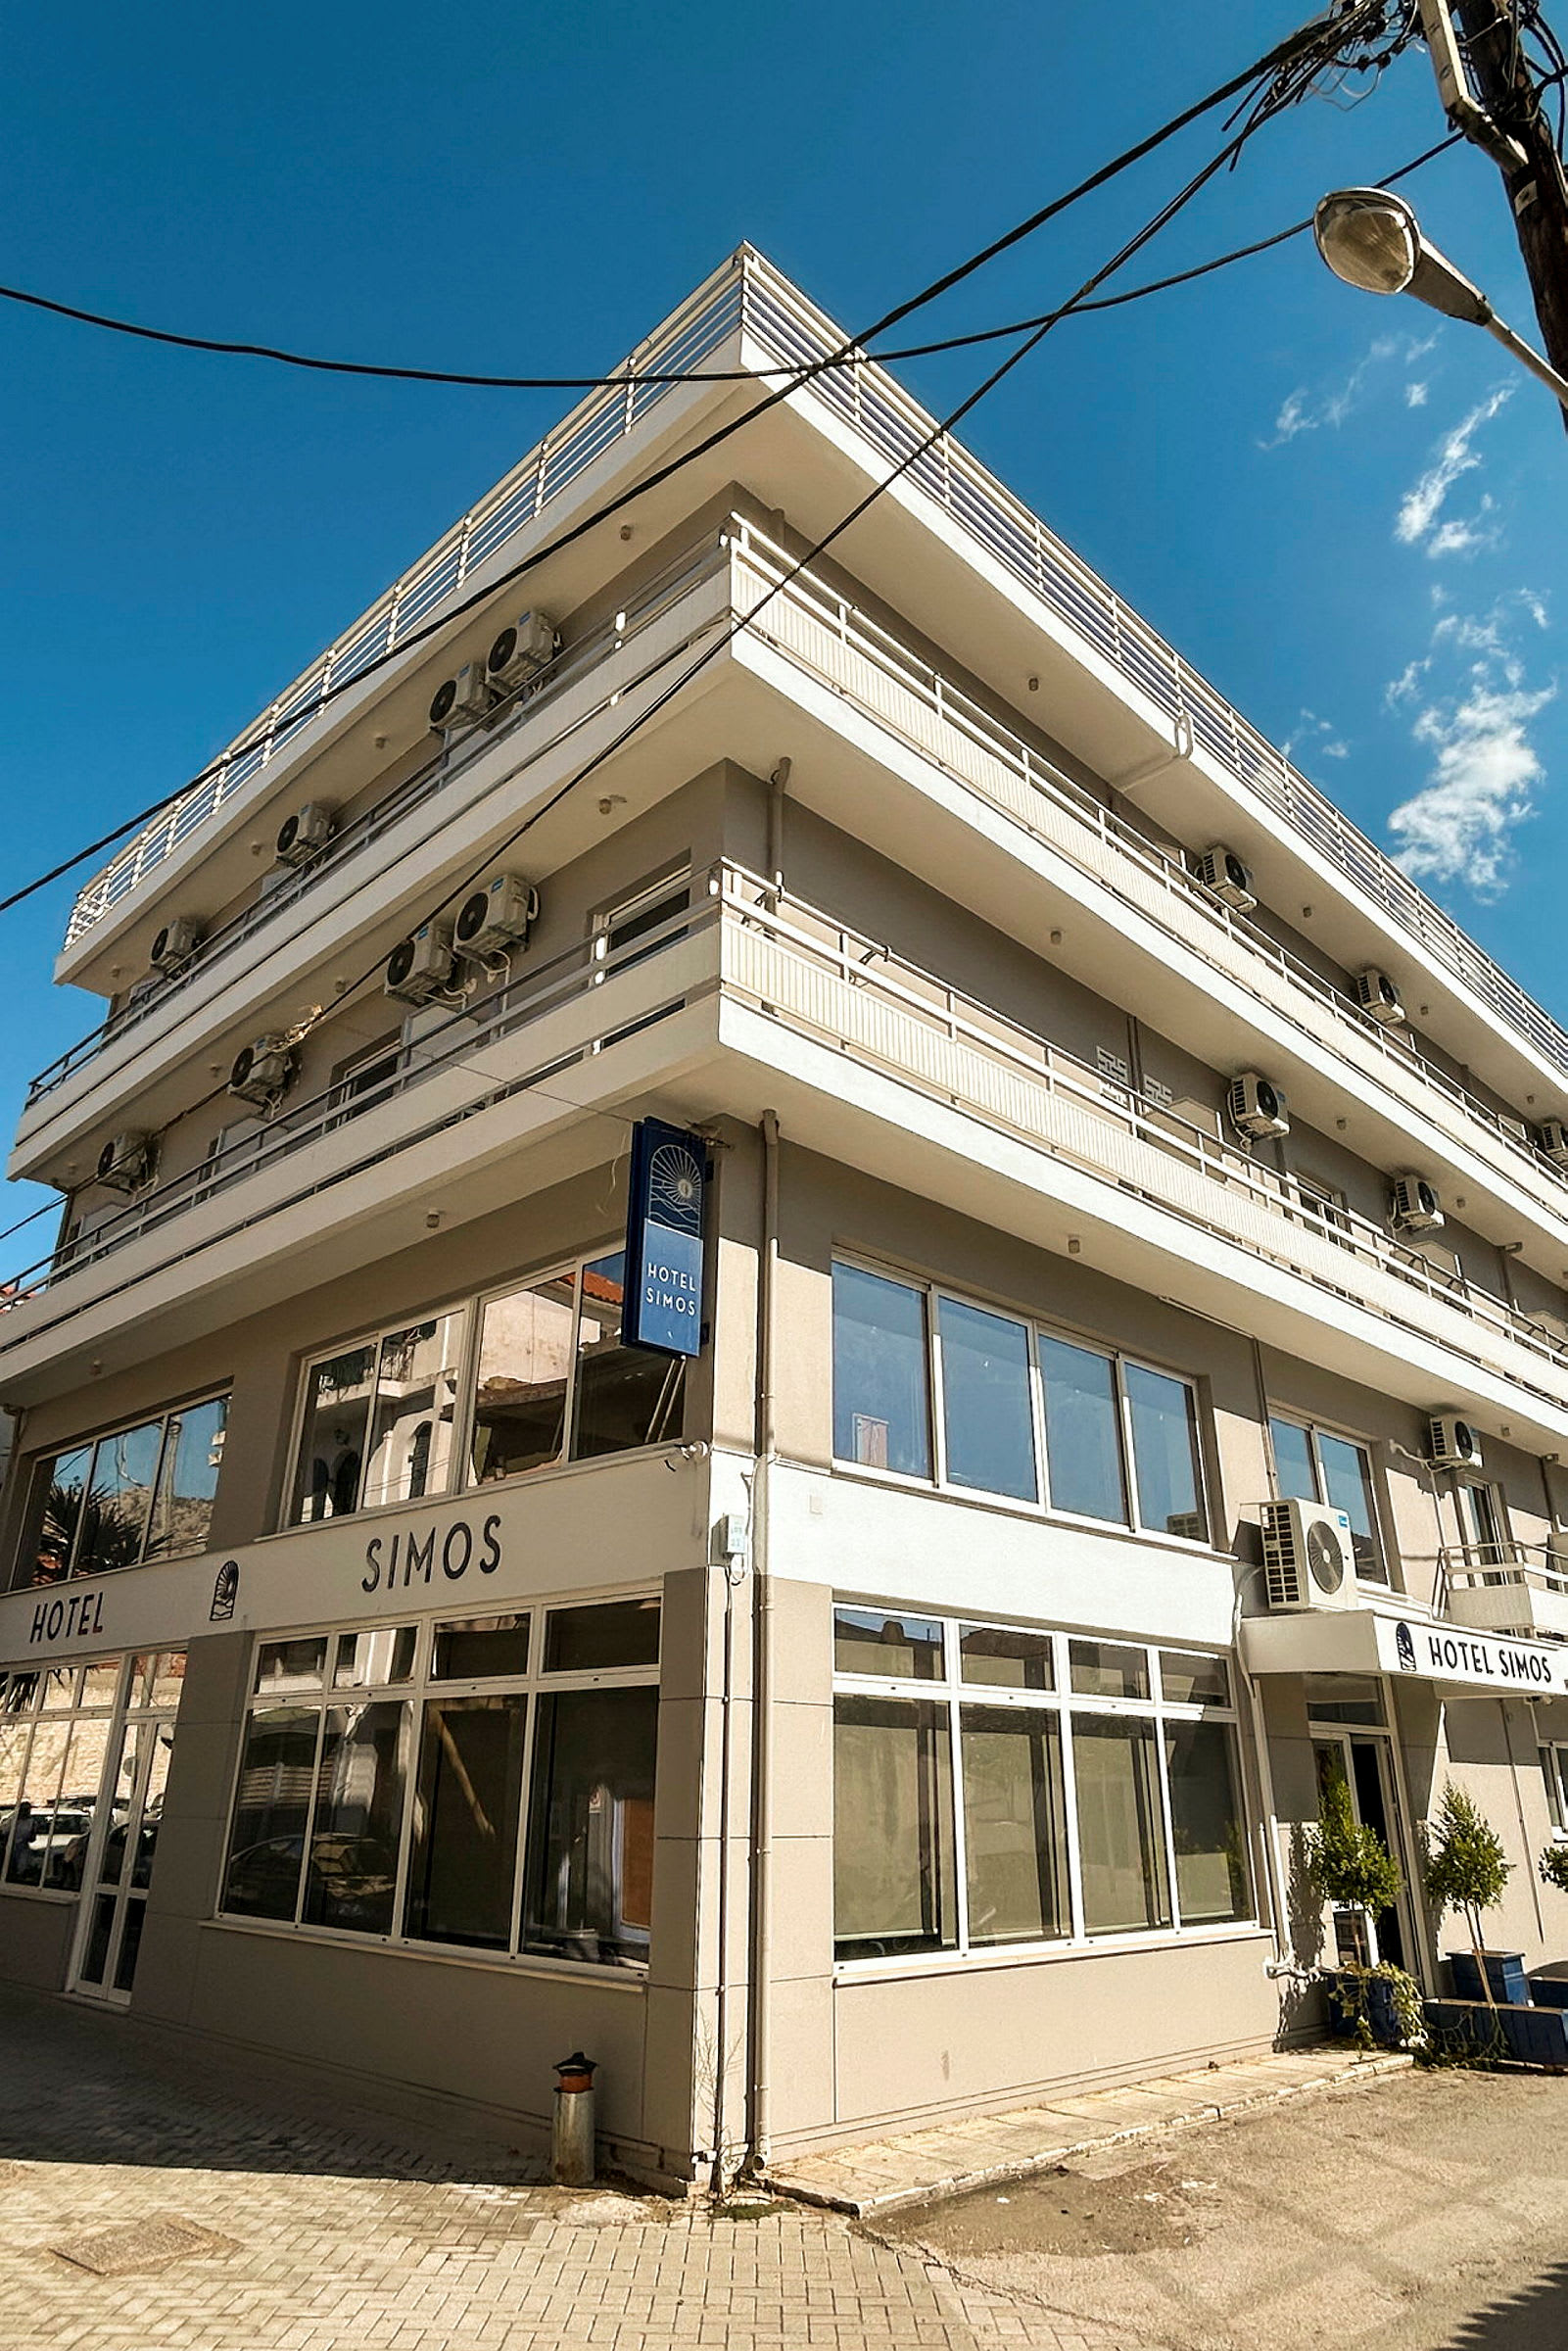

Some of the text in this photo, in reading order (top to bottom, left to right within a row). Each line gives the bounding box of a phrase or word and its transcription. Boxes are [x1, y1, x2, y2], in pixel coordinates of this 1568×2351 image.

[646, 1262, 696, 1293] HOTEL
[645, 1287, 696, 1316] SIMOS
[29, 1514, 501, 1643] HOTEL SIMOS
[1428, 1636, 1552, 1682] HOTEL SIMOS
